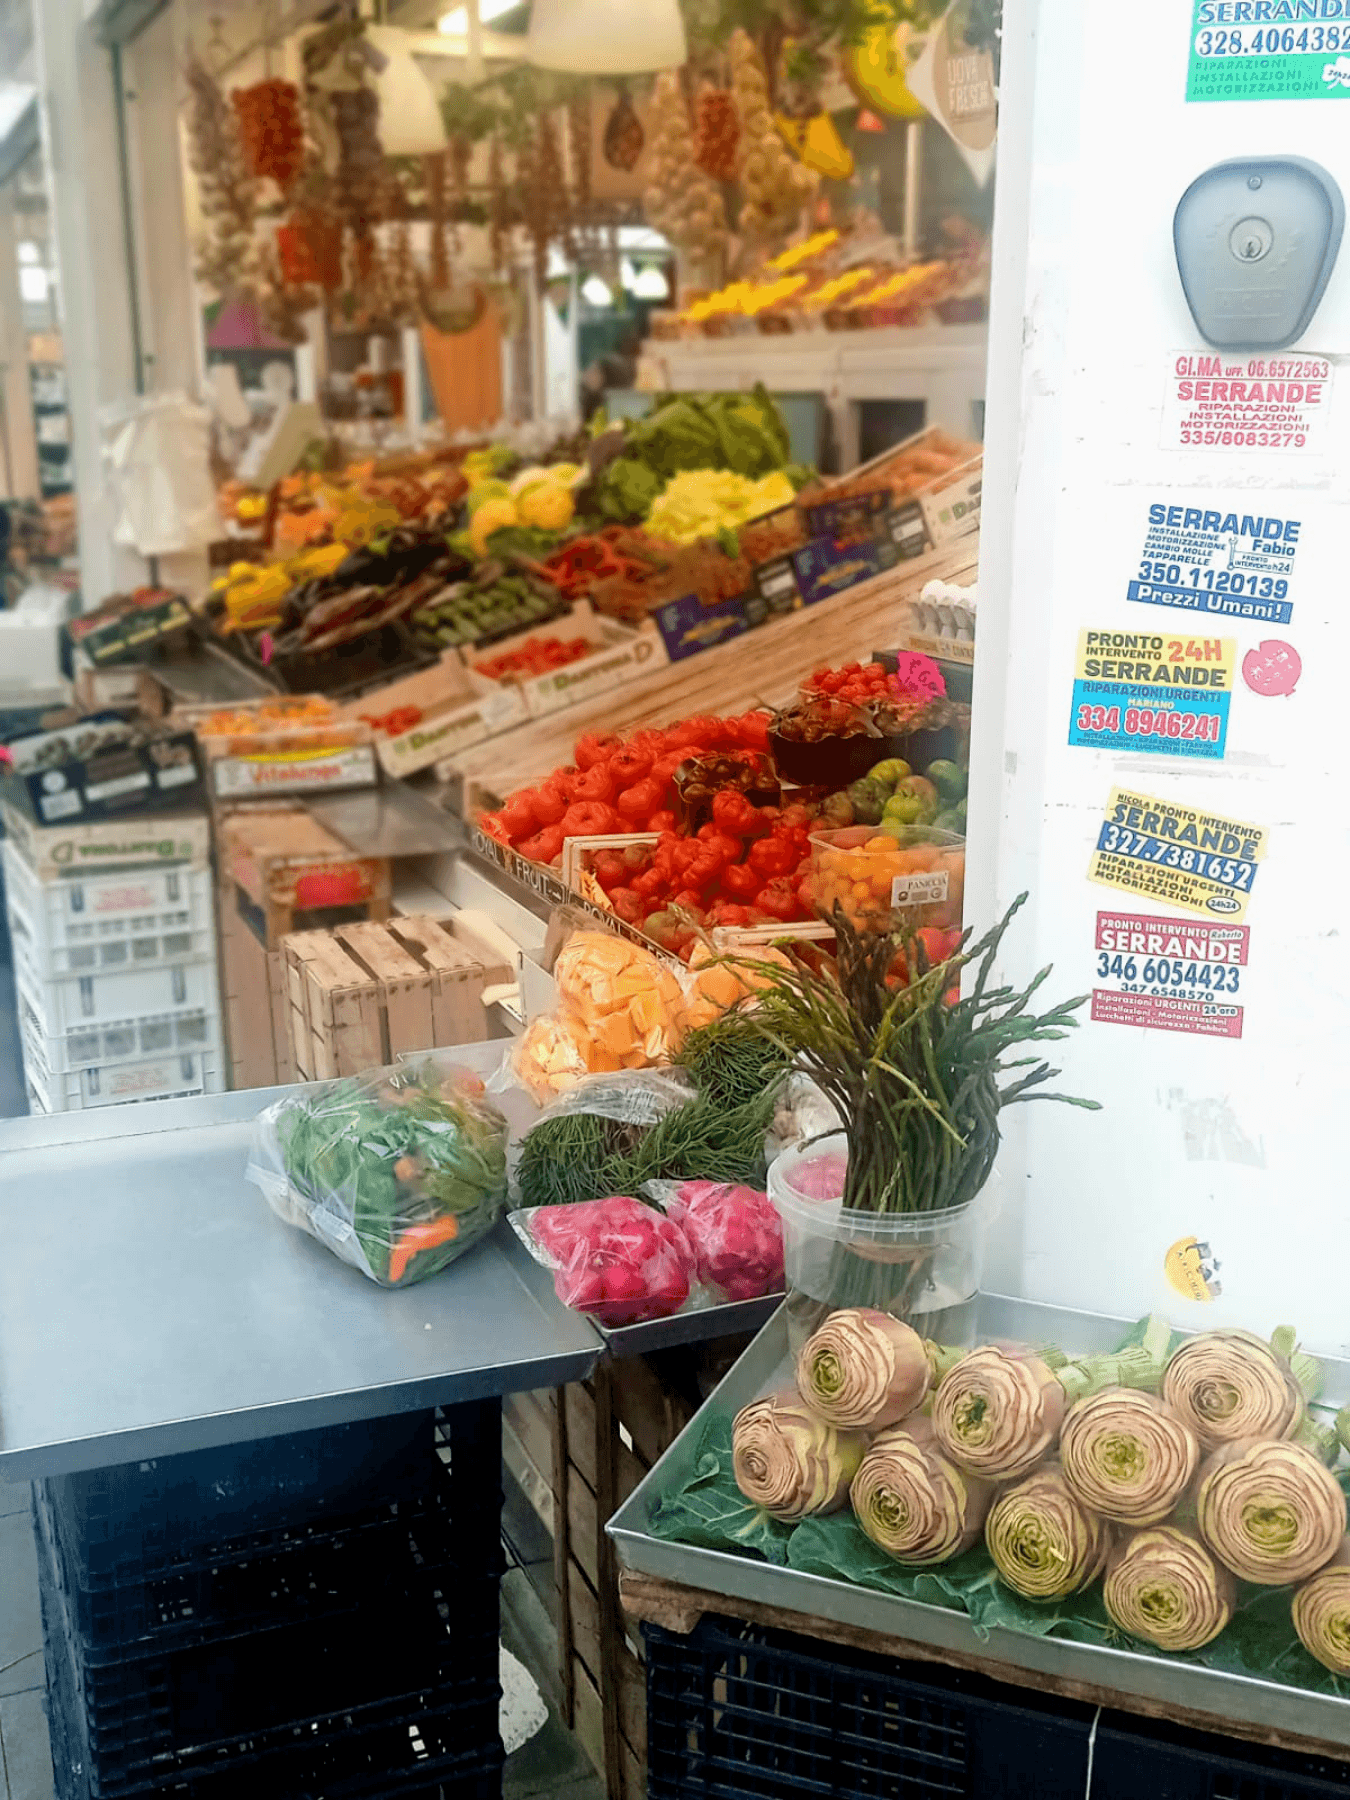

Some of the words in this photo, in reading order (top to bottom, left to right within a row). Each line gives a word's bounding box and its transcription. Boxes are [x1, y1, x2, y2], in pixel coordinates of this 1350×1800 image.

[1194, 69, 1302, 83] INSTALLAZIONI
[1193, 81, 1319, 95] MOTORIZZAZIONI
[1247, 359, 1330, 379] 06.6572563
[1177, 381, 1323, 404] SERRANDE
[1189, 412, 1303, 422] INSTALLAZIONI
[1198, 403, 1296, 413] RIPARAZIONI
[1180, 421, 1310, 432] MOTORIZZAZIONI
[1180, 430, 1306, 448] 335/8083279
[1148, 504, 1302, 543] SERRANDE
[1149, 526, 1220, 541] INSTALLAZIONE
[1144, 541, 1181, 552] CAMBIO
[1182, 547, 1213, 557] MOLLE
[1146, 534, 1227, 550] MOTORIZZAZIONE
[1252, 538, 1296, 556] Fabio
[1142, 549, 1211, 566] TAPPARELLE
[1138, 560, 1288, 599] 350.1120139
[1137, 584, 1201, 607] Prezzi
[1207, 593, 1283, 620] Umani!
[1086, 631, 1164, 650] PRONTO
[1167, 639, 1223, 663] 24H
[1086, 646, 1162, 660] INTERVENTO
[1084, 659, 1228, 688] SERRANDE
[1083, 682, 1164, 699] RIPARAZIONI
[1165, 688, 1222, 703] URGENTI
[1078, 704, 1120, 732] 334
[1125, 708, 1221, 741] 8946241
[1117, 793, 1150, 810] NICOLA
[1153, 802, 1197, 822] PRONTO
[1199, 815, 1263, 840] INTERVENTO
[1111, 803, 1259, 862] SERRANDE
[472, 831, 501, 865] OYAL
[1104, 825, 1252, 890] 327.7381652
[1097, 861, 1193, 895] INSTALLAZIONI
[1100, 852, 1179, 883] RIPARAZIONI
[1183, 873, 1235, 898] URGENTI
[1094, 869, 1203, 907] MOTORIZZAZIONI
[1210, 898, 1237, 910] 24h24
[1100, 918, 1142, 931] PRONTO
[1145, 922, 1208, 939] INTERVENTO
[1100, 929, 1242, 964] SERRANDE
[1097, 952, 1137, 981] 346
[1143, 957, 1240, 993] 6054423
[1120, 982, 1148, 994] 347
[1151, 985, 1215, 1002] 6548570
[1096, 992, 1153, 1007] Riparazioni
[1154, 998, 1201, 1013] URGENTI
[1204, 1005, 1217, 1015] 24
